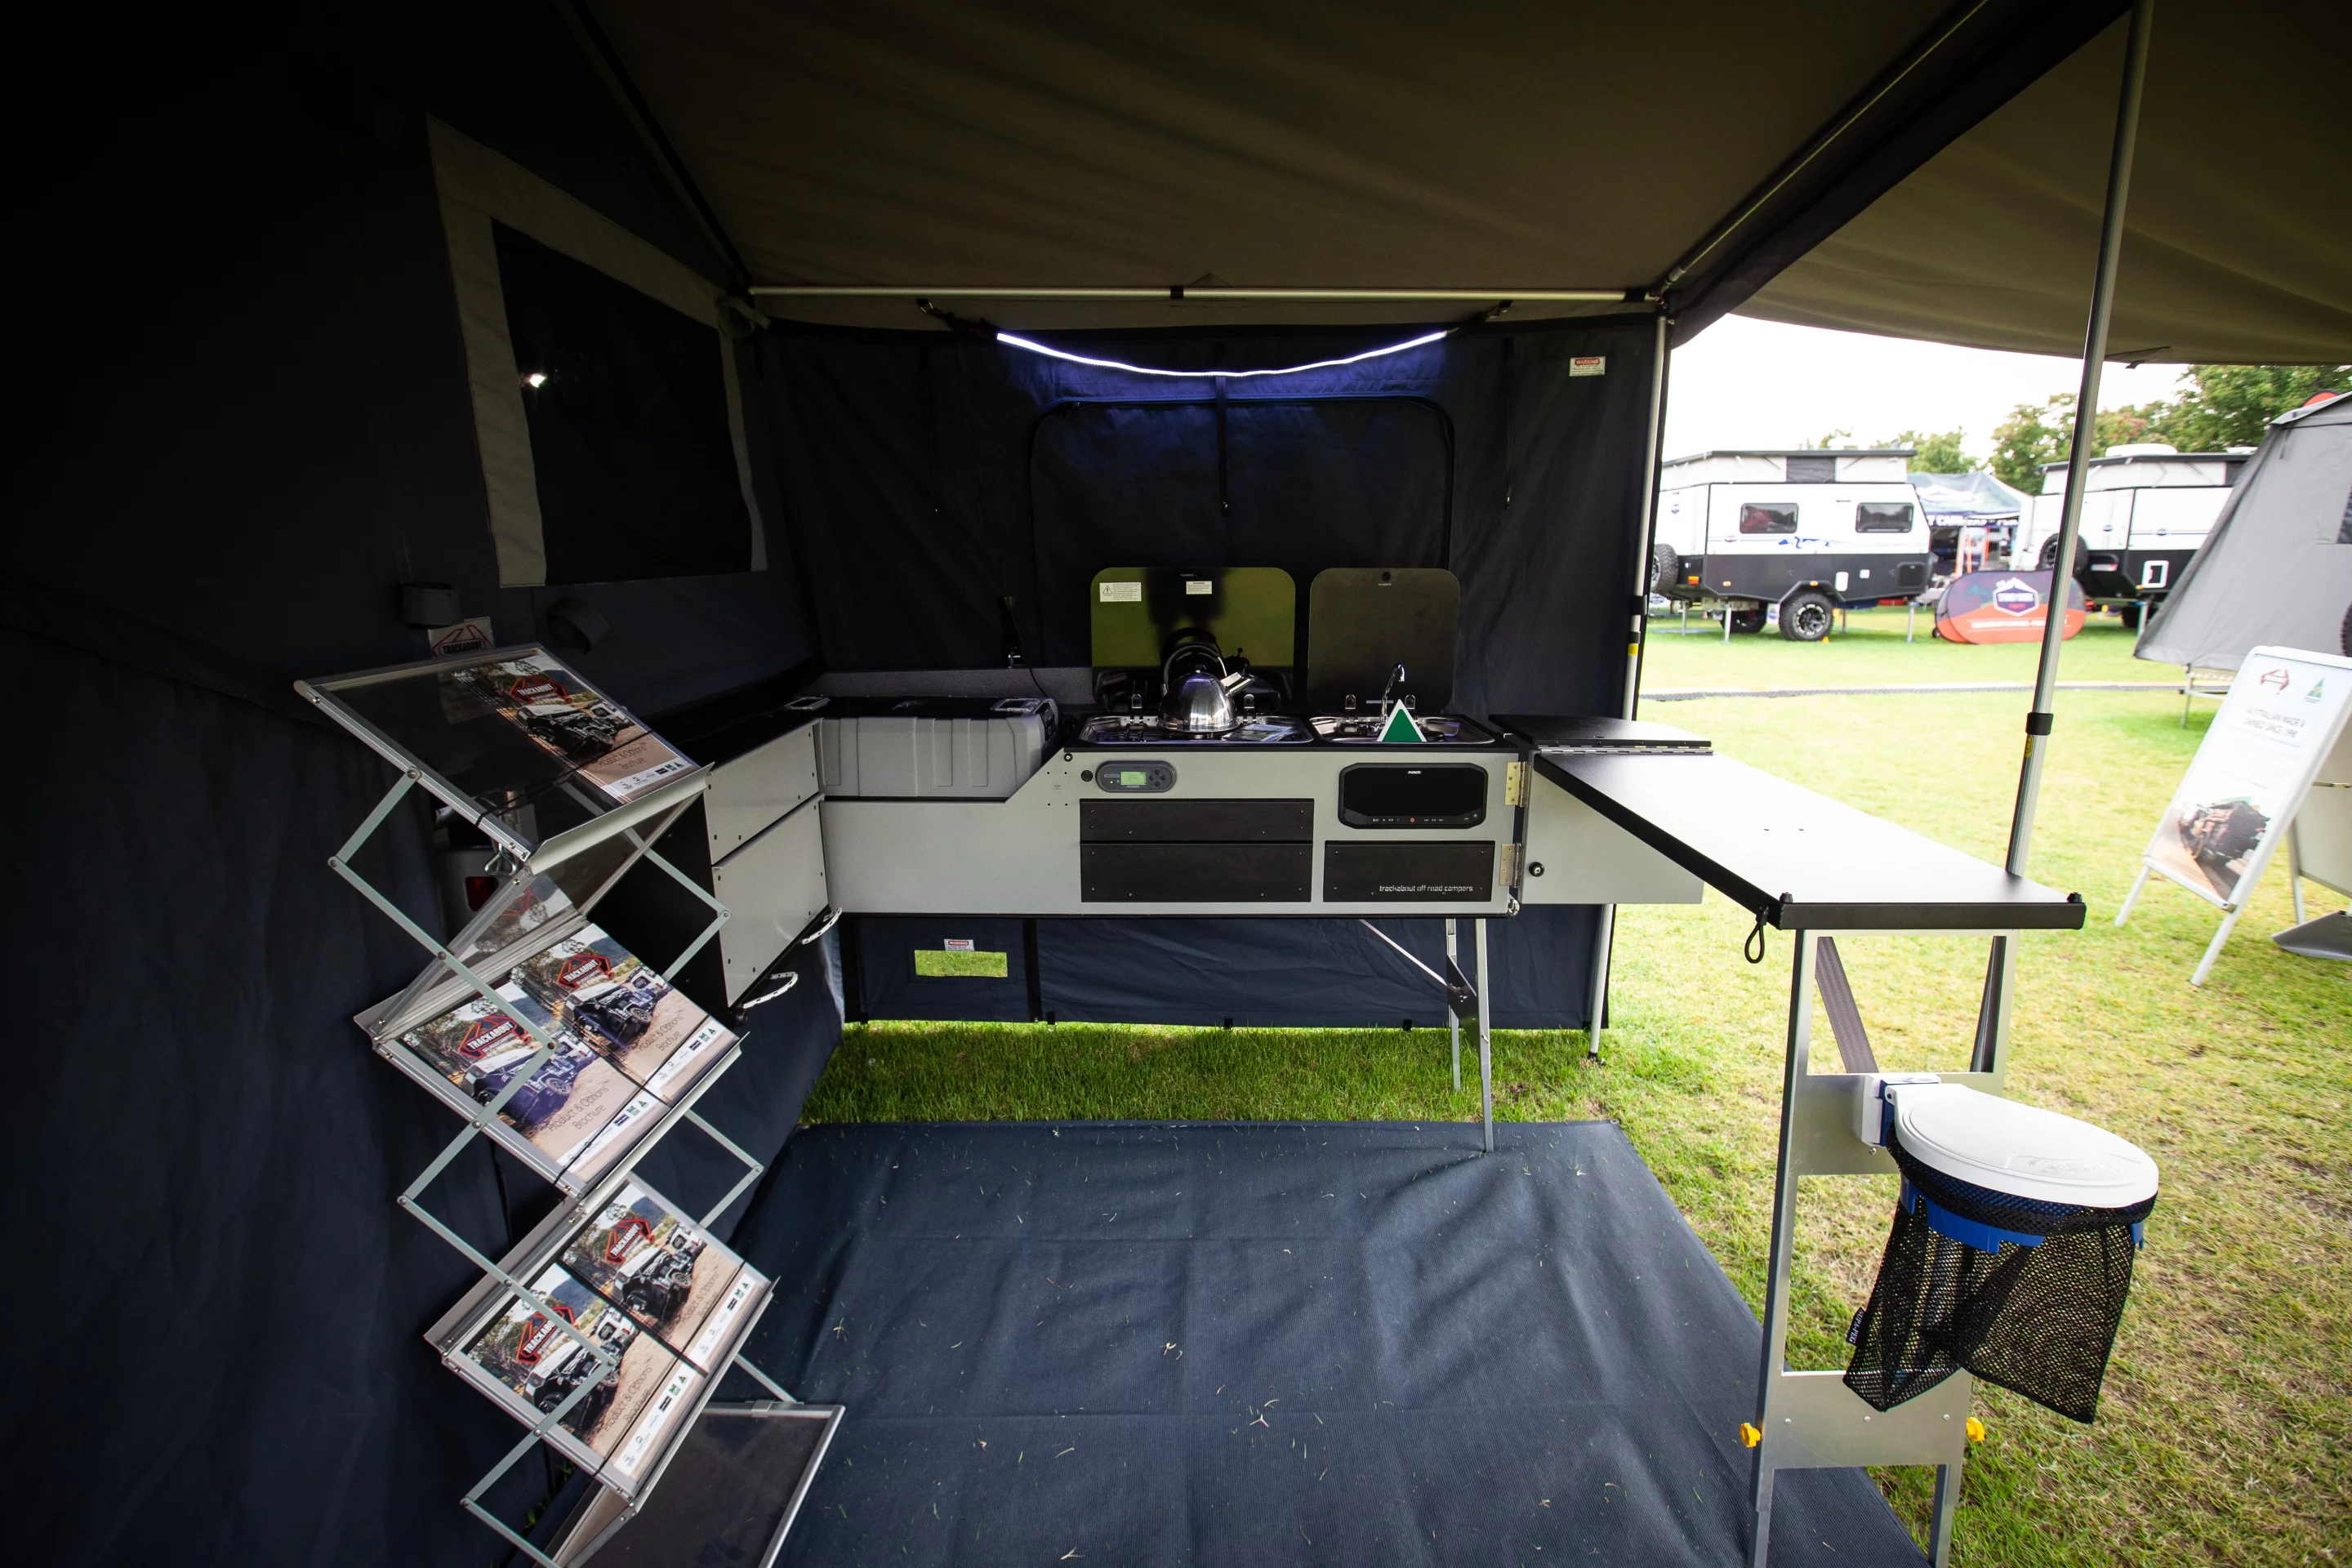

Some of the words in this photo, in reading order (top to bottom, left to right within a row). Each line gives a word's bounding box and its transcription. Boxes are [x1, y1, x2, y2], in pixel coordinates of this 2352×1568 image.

[442, 640, 482, 654] TRACKABOUT
[516, 684, 555, 696] TRACKABOUT
[1444, 885, 1473, 893] campers
[564, 959, 599, 982] TRACKABOUT
[466, 1021, 514, 1050] TRACKABOUT
[638, 1031, 658, 1052] Product
[660, 1015, 684, 1034] Options
[656, 1031, 683, 1052] Brochure
[547, 1109, 575, 1132] Product
[573, 1103, 584, 1113] &
[580, 1086, 609, 1107] Options
[572, 1104, 606, 1130] Brochure
[610, 1223, 641, 1256] TRACKABOUT
[523, 1319, 556, 1354] TRACKABO
[1849, 1308, 1864, 1344] SUPA-PEG
[604, 1400, 626, 1432] Product
[623, 1394, 632, 1402] &
[628, 1366, 653, 1395] Options
[623, 1388, 651, 1423] Brochure
